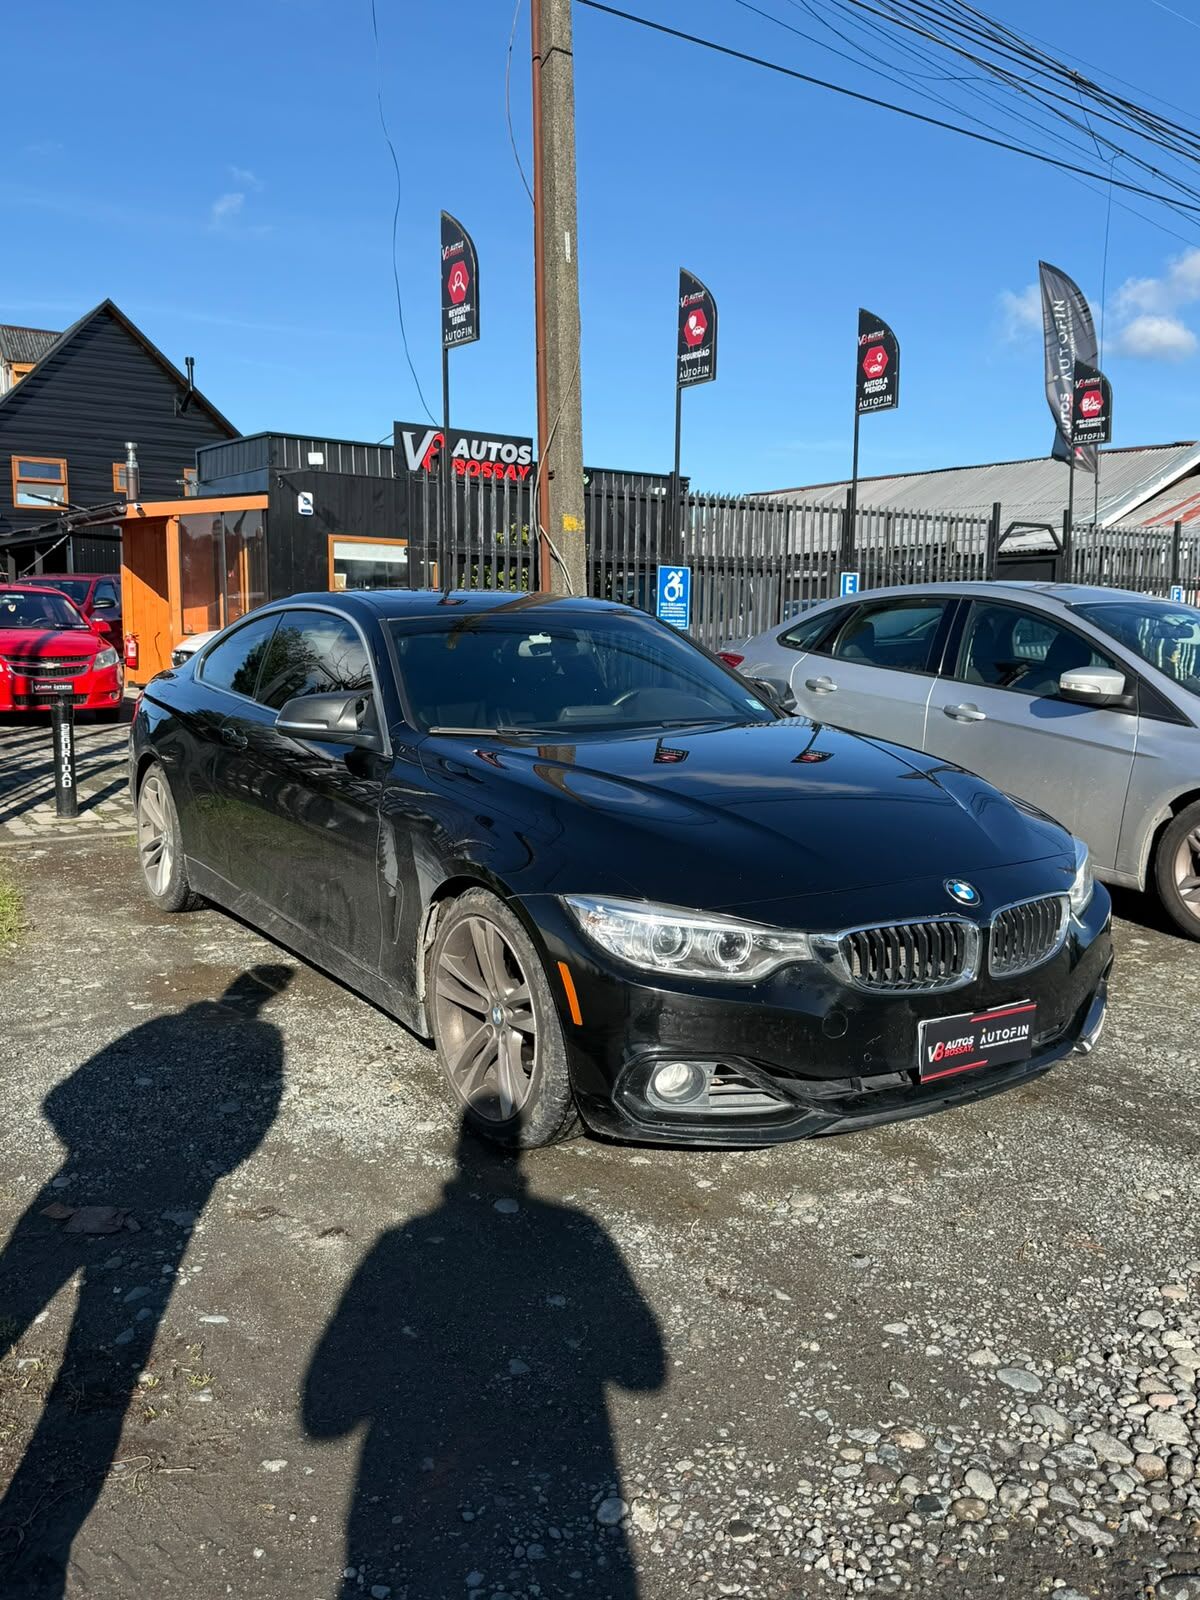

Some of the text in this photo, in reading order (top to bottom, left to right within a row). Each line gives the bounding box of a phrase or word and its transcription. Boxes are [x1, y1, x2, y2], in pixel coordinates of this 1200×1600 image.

[448, 303, 471, 319] REVISIÓN
[452, 314, 467, 325] LEGAL
[445, 326, 473, 341] AUTOFIN
[1053, 300, 1073, 381] AUTOFIN
[680, 348, 710, 361] SEGURIDAD
[680, 365, 710, 378] AUTOFIN
[864, 377, 889, 389] AUTOS A
[865, 384, 887, 394] PEDIDO
[859, 394, 892, 408] AUTOFIN
[1073, 432, 1106, 441] AUTOFIN
[451, 438, 532, 465] AUTOS
[451, 458, 531, 481] BOSSAY
[846, 576, 854, 594] E
[61, 723, 72, 788] SEGURIDAD
[928, 1041, 945, 1062] V8
[945, 1036, 974, 1050] AUTOS
[980, 1024, 1030, 1045] AUTOFIN
[944, 1044, 973, 1057] BOSSAY
